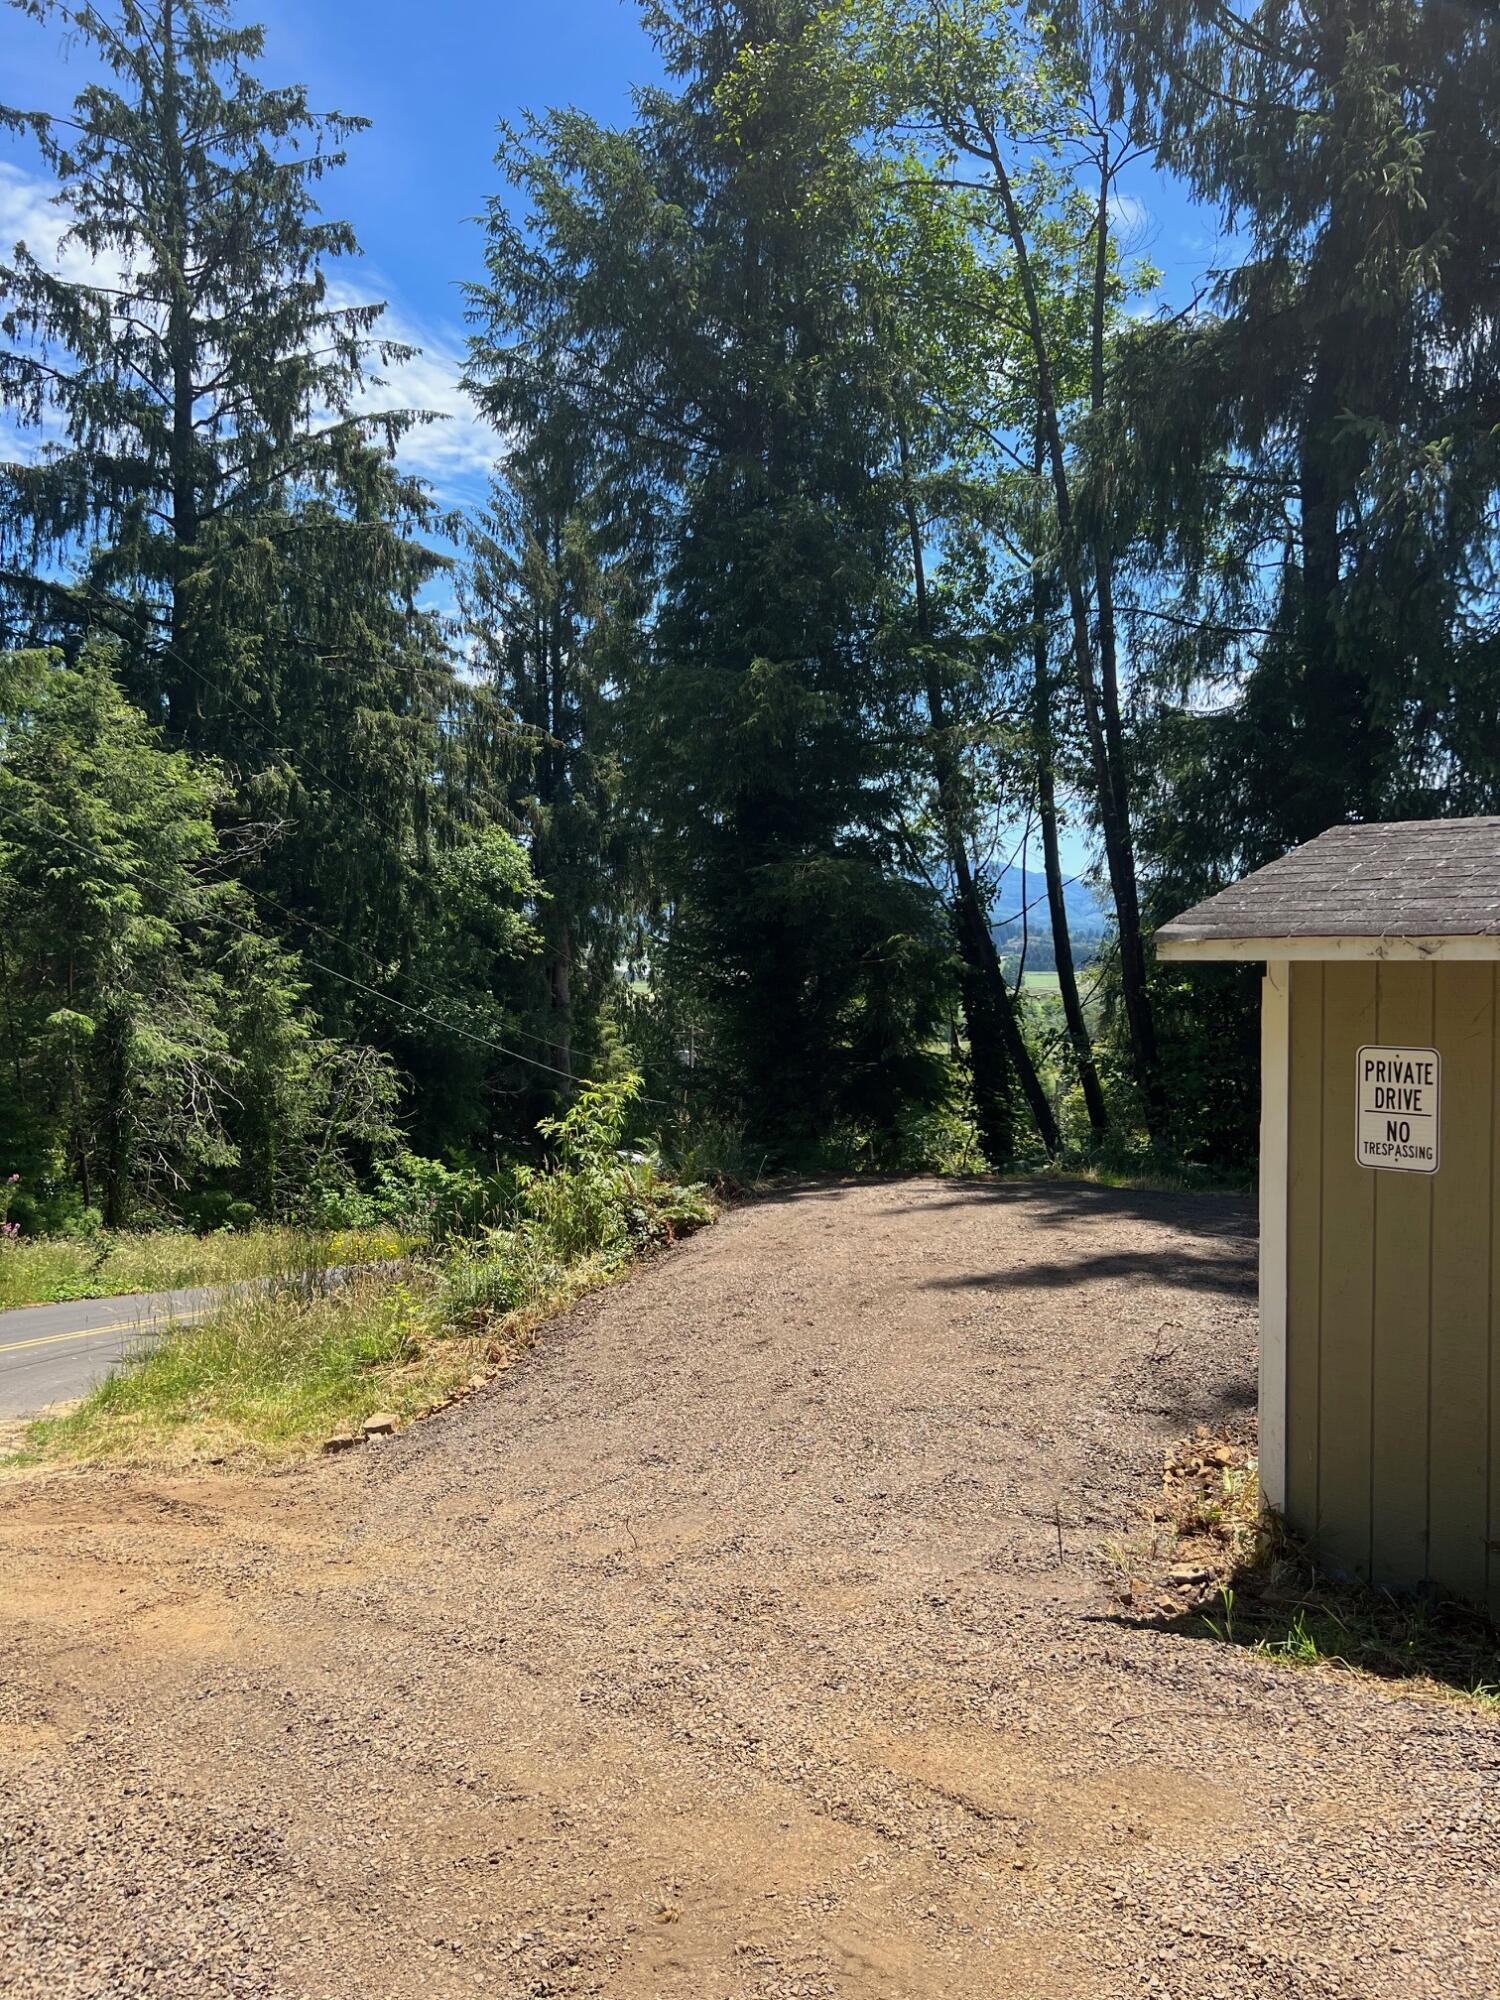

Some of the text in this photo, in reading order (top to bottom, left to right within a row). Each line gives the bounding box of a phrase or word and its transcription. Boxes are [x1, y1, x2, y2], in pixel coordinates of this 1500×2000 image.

[1365, 1060, 1434, 1085] PRIVATE
[1375, 1087, 1422, 1111] DRIVE
[1386, 1120, 1410, 1143] NO
[1363, 1141, 1433, 1160] TRESPASSING
